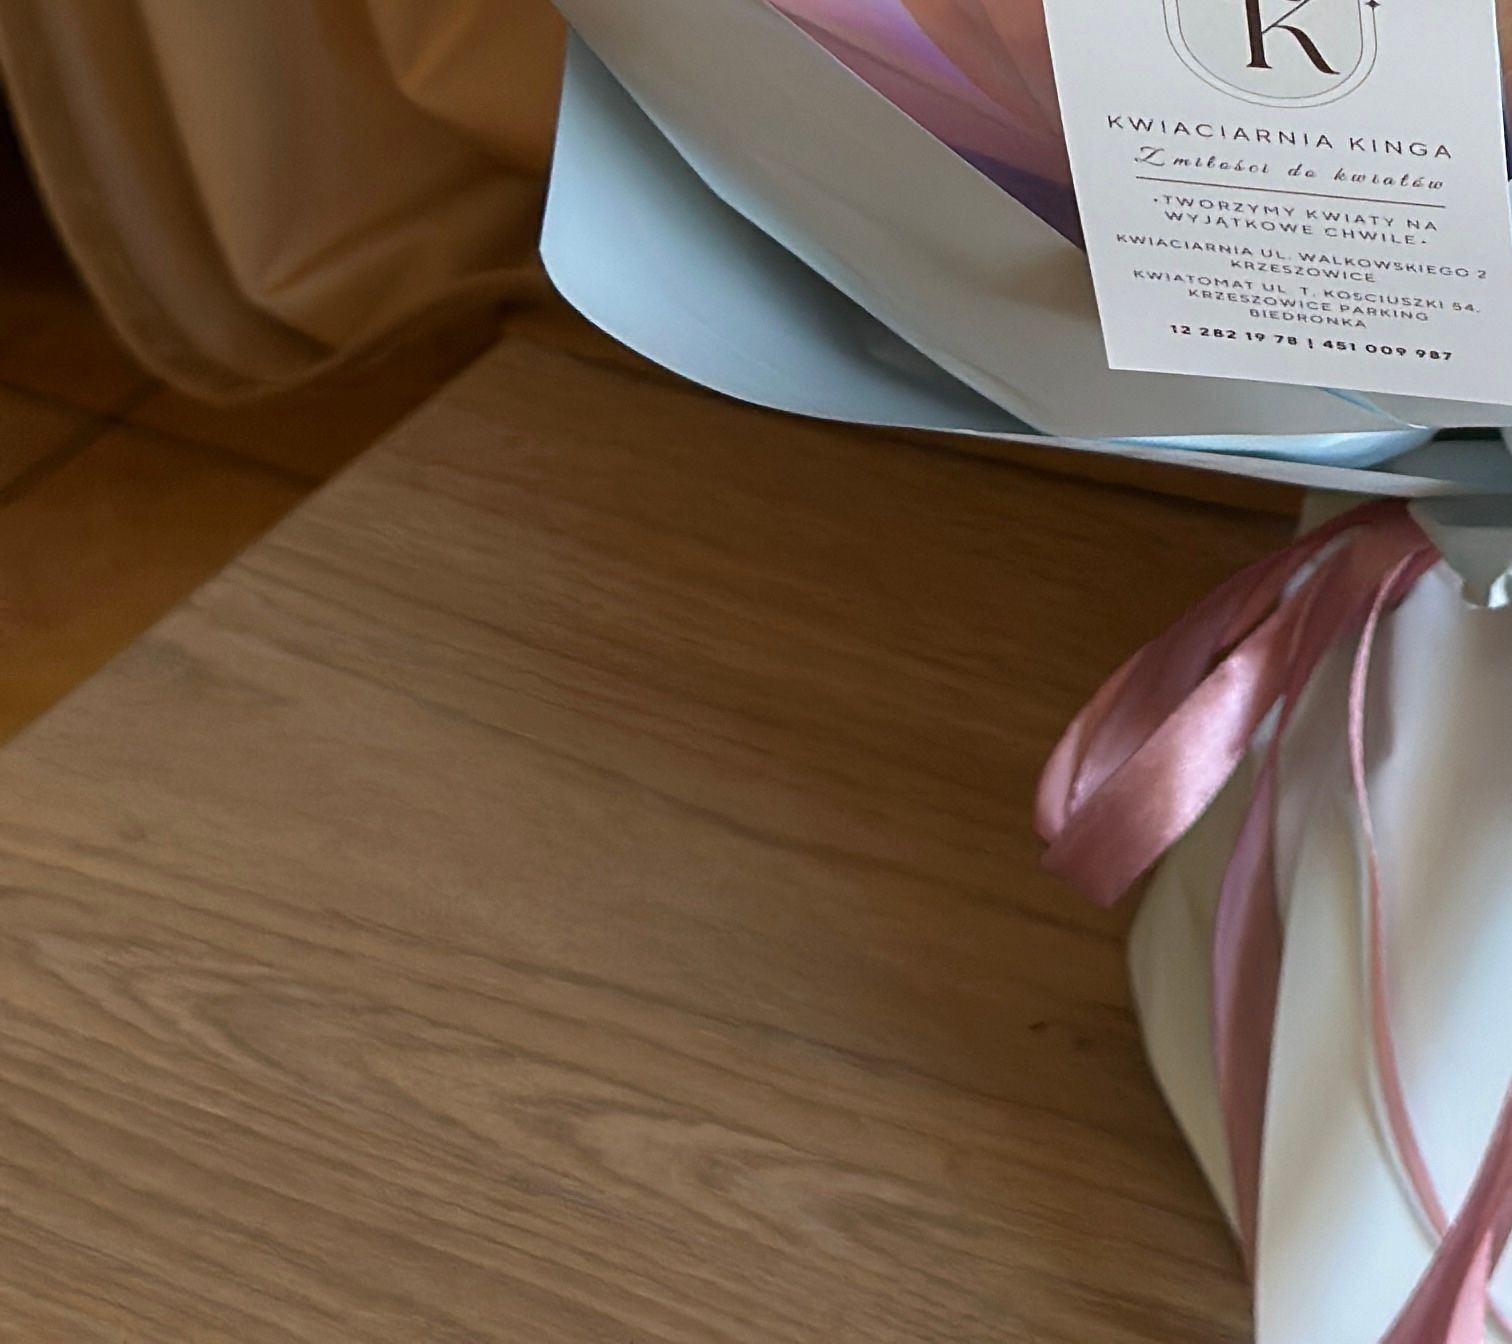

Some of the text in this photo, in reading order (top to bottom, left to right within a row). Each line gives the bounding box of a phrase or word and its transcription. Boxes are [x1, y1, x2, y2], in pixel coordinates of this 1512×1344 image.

[1107, 114, 1452, 159] KWIACIARNIA KINGA
[1287, 163, 1318, 179] do
[1164, 211, 1313, 235] WYJĄTKOWE
[1306, 209, 1395, 228] KWIATY
[1407, 218, 1438, 231] NA
[1116, 233, 1253, 256] KWIACIARNIA
[1299, 252, 1470, 278] WALKOWSKIEGO
[1478, 270, 1488, 279] 2
[1133, 269, 1253, 290] KWIATOMAT
[1230, 259, 1376, 283] KRZESZOWICE
[1188, 288, 1430, 322] KRZESZOWICE PARKING
[1249, 308, 1367, 329] BIEDRONKA
[1170, 324, 1192, 335] 12
[1199, 327, 1237, 340] 282
[1245, 331, 1266, 342] 19
[1273, 334, 1298, 346] 78
[1323, 340, 1357, 352] 451
[1365, 344, 1407, 356] 009
[1415, 349, 1453, 361] 987
